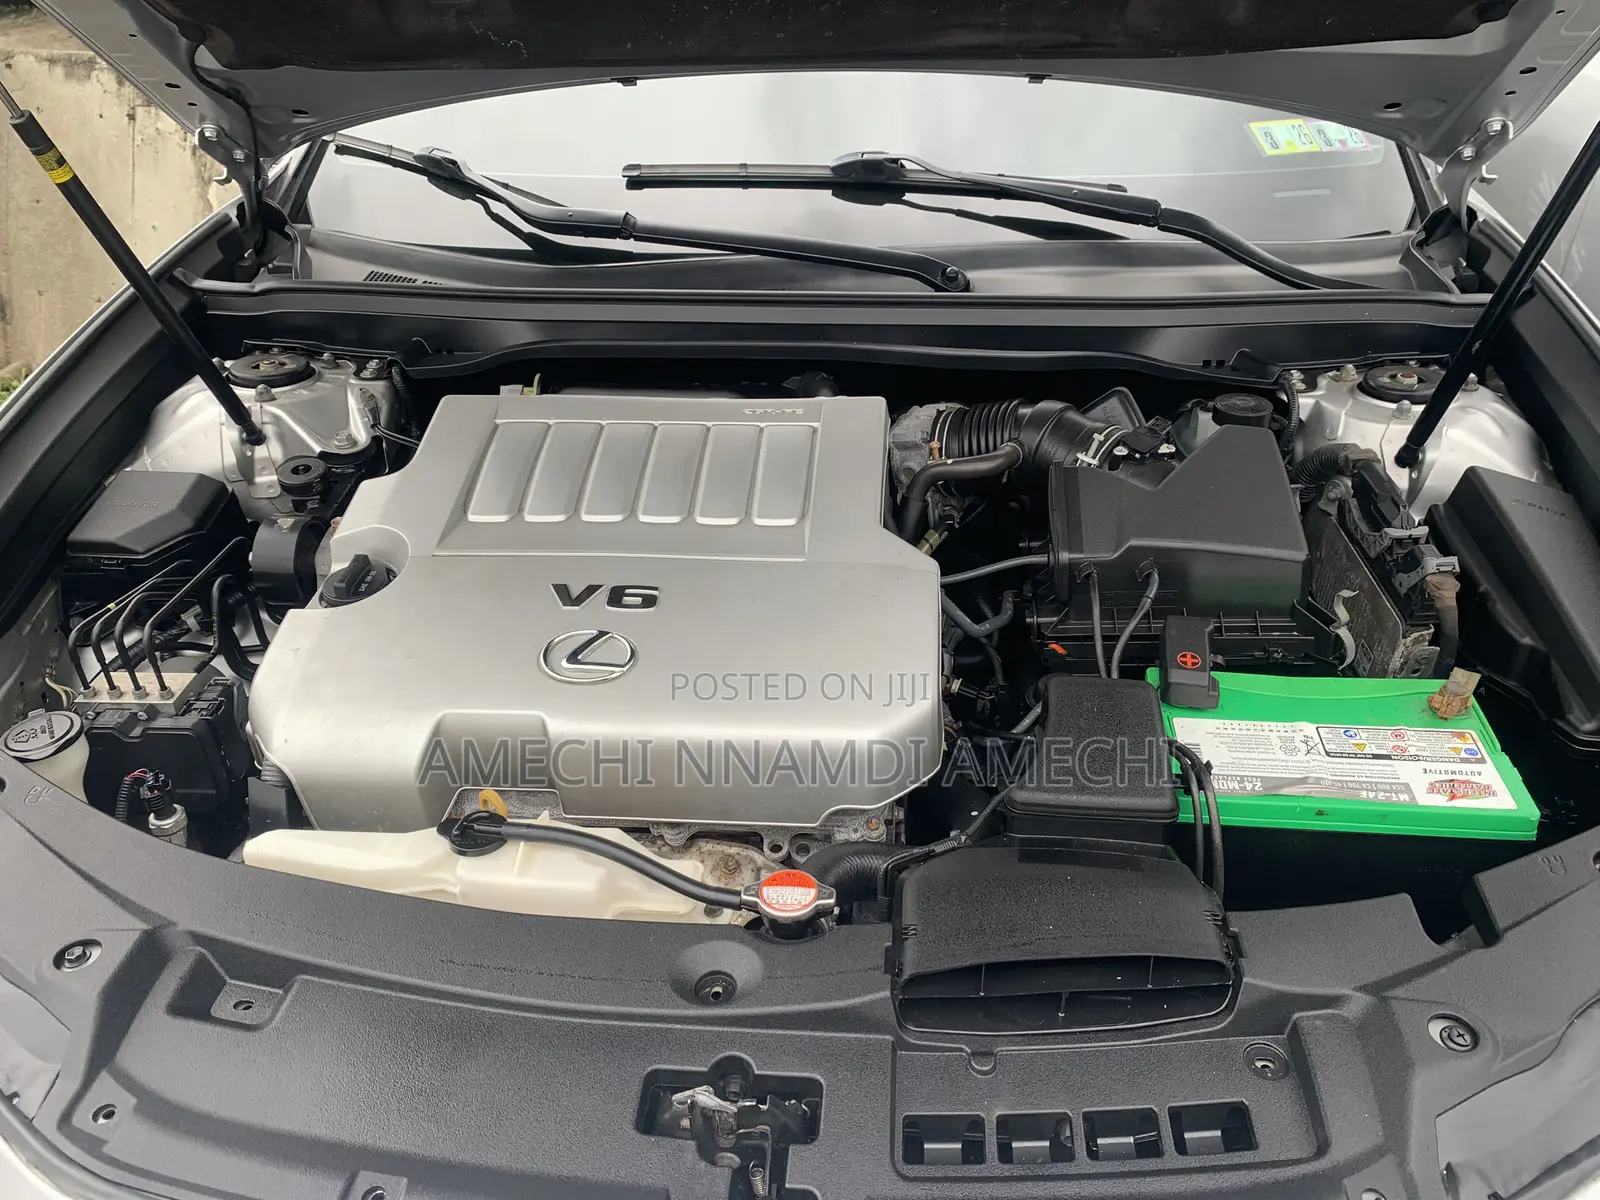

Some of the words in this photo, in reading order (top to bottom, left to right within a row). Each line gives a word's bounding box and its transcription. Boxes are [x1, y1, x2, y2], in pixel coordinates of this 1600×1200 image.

[551, 583, 660, 612] V6
[1391, 754, 1461, 763] DANGER/POISON
[1422, 768, 1482, 777] AUTOMOTIVE
